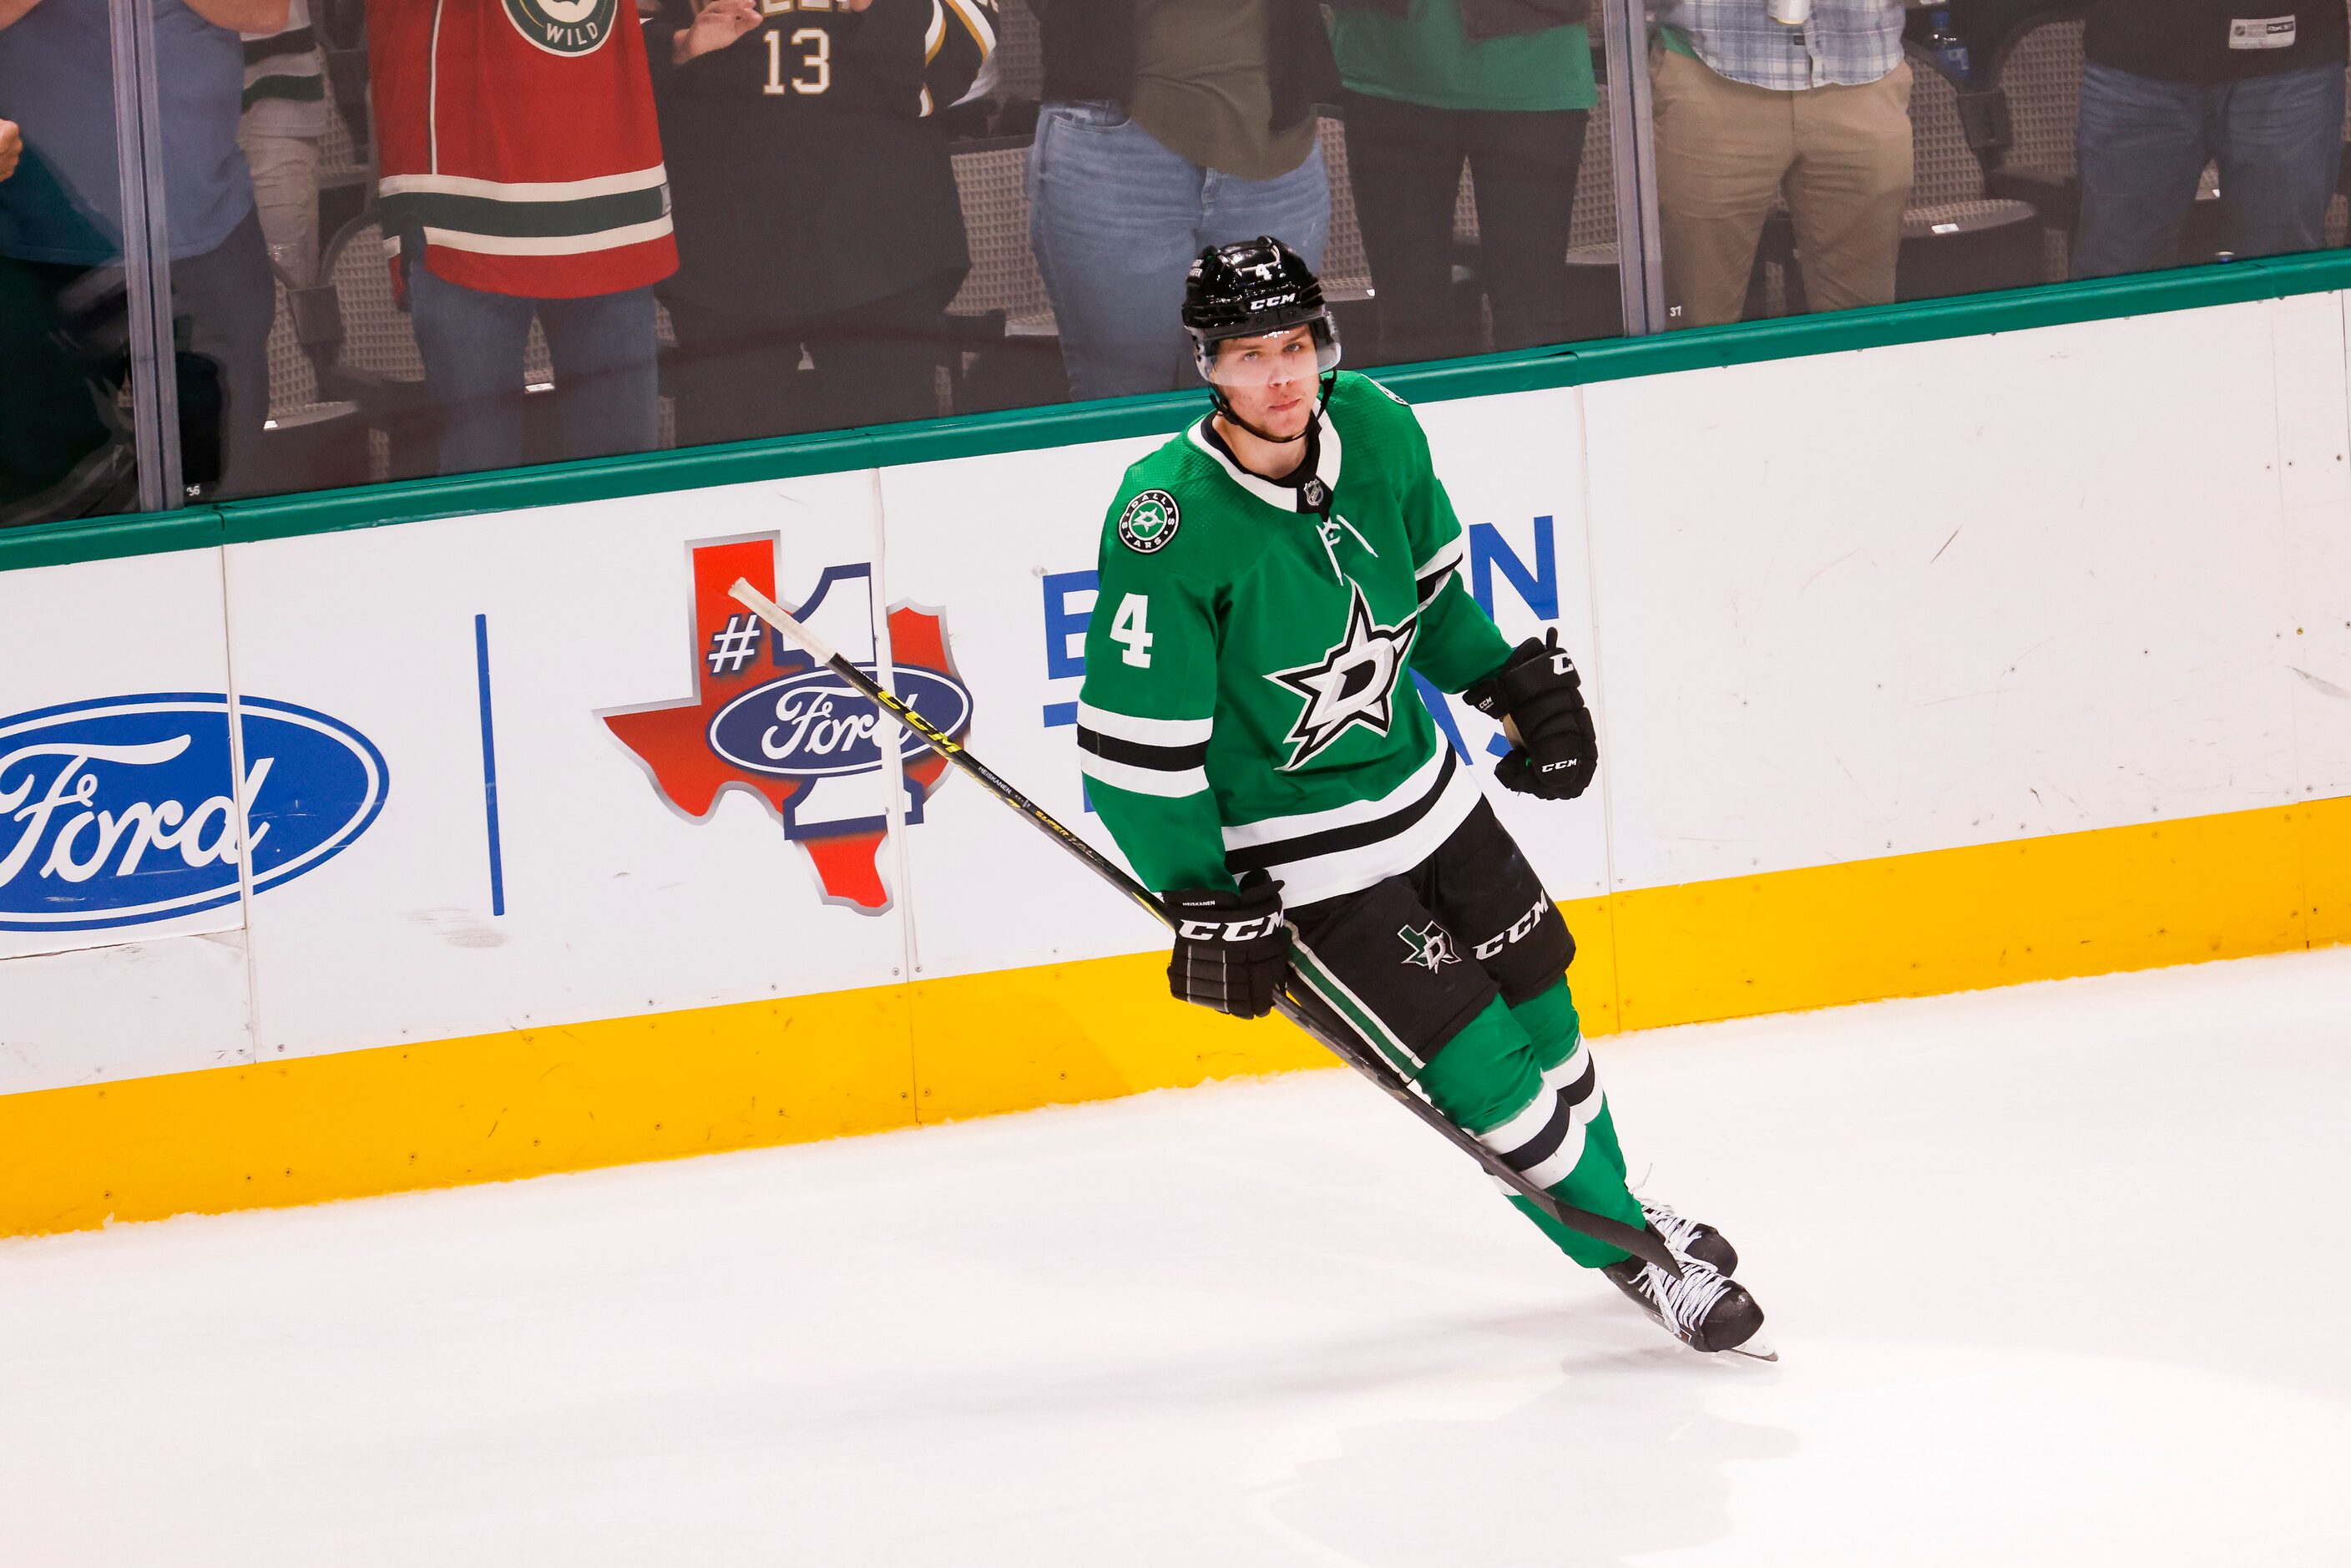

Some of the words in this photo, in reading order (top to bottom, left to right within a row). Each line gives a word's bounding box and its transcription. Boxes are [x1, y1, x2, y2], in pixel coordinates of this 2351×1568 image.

[547, 22, 599, 46] WILD
[763, 28, 831, 94] 13
[1255, 263, 1272, 281] 4
[1250, 292, 1297, 311] CCM
[1670, 306, 1681, 316] 37
[186, 485, 200, 497] 36
[1130, 493, 1176, 526] DALLAS
[1121, 521, 1162, 549] STARS
[1110, 592, 1154, 669] 4
[1479, 696, 1492, 709] CCM
[761, 685, 919, 761] Ford
[877, 689, 963, 753] CCM
[1541, 758, 1577, 773] CCM
[978, 766, 1013, 795] HEISKANEN
[0, 734, 275, 888] Ford
[1035, 810, 1069, 837] SUPER
[1178, 910, 1284, 942] CCM
[1472, 888, 1550, 960] CCM
